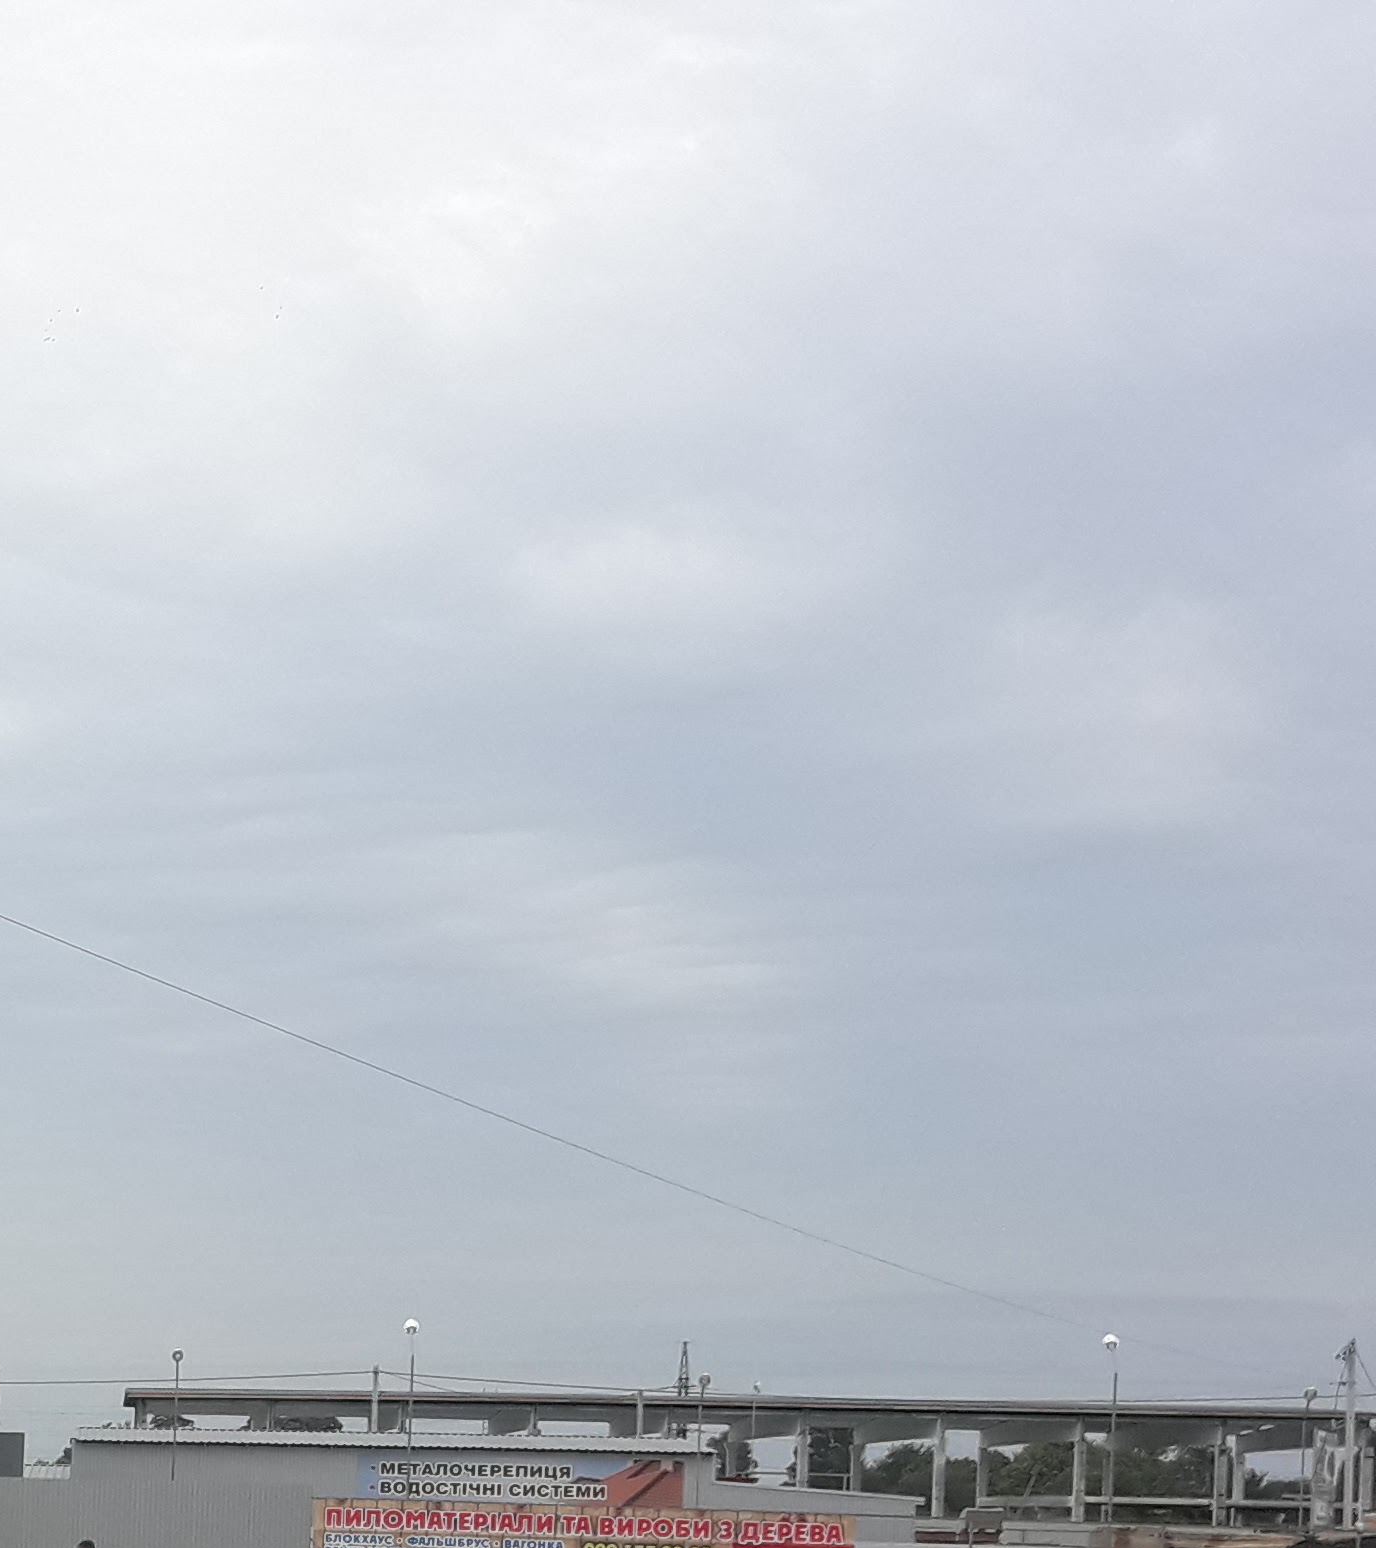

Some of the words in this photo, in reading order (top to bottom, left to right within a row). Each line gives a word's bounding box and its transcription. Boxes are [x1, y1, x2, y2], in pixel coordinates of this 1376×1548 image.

[380, 1462, 571, 1481] МЕТАЛОЧЕРЕПИЦЯ
[380, 1482, 502, 1499] ВОДОСТІЧНІ
[508, 1485, 607, 1499] СИСТЕМИ
[325, 1508, 555, 1534] ПИЛОМАТЕРІАЛИ
[563, 1516, 591, 1535] ТА
[599, 1517, 711, 1539] ВИРОБИ
[740, 1521, 844, 1545] ДЕРЕВА
[325, 1533, 393, 1546] БЛОКХАУС
[406, 1537, 490, 1548] ФАЛЬШБРУС
